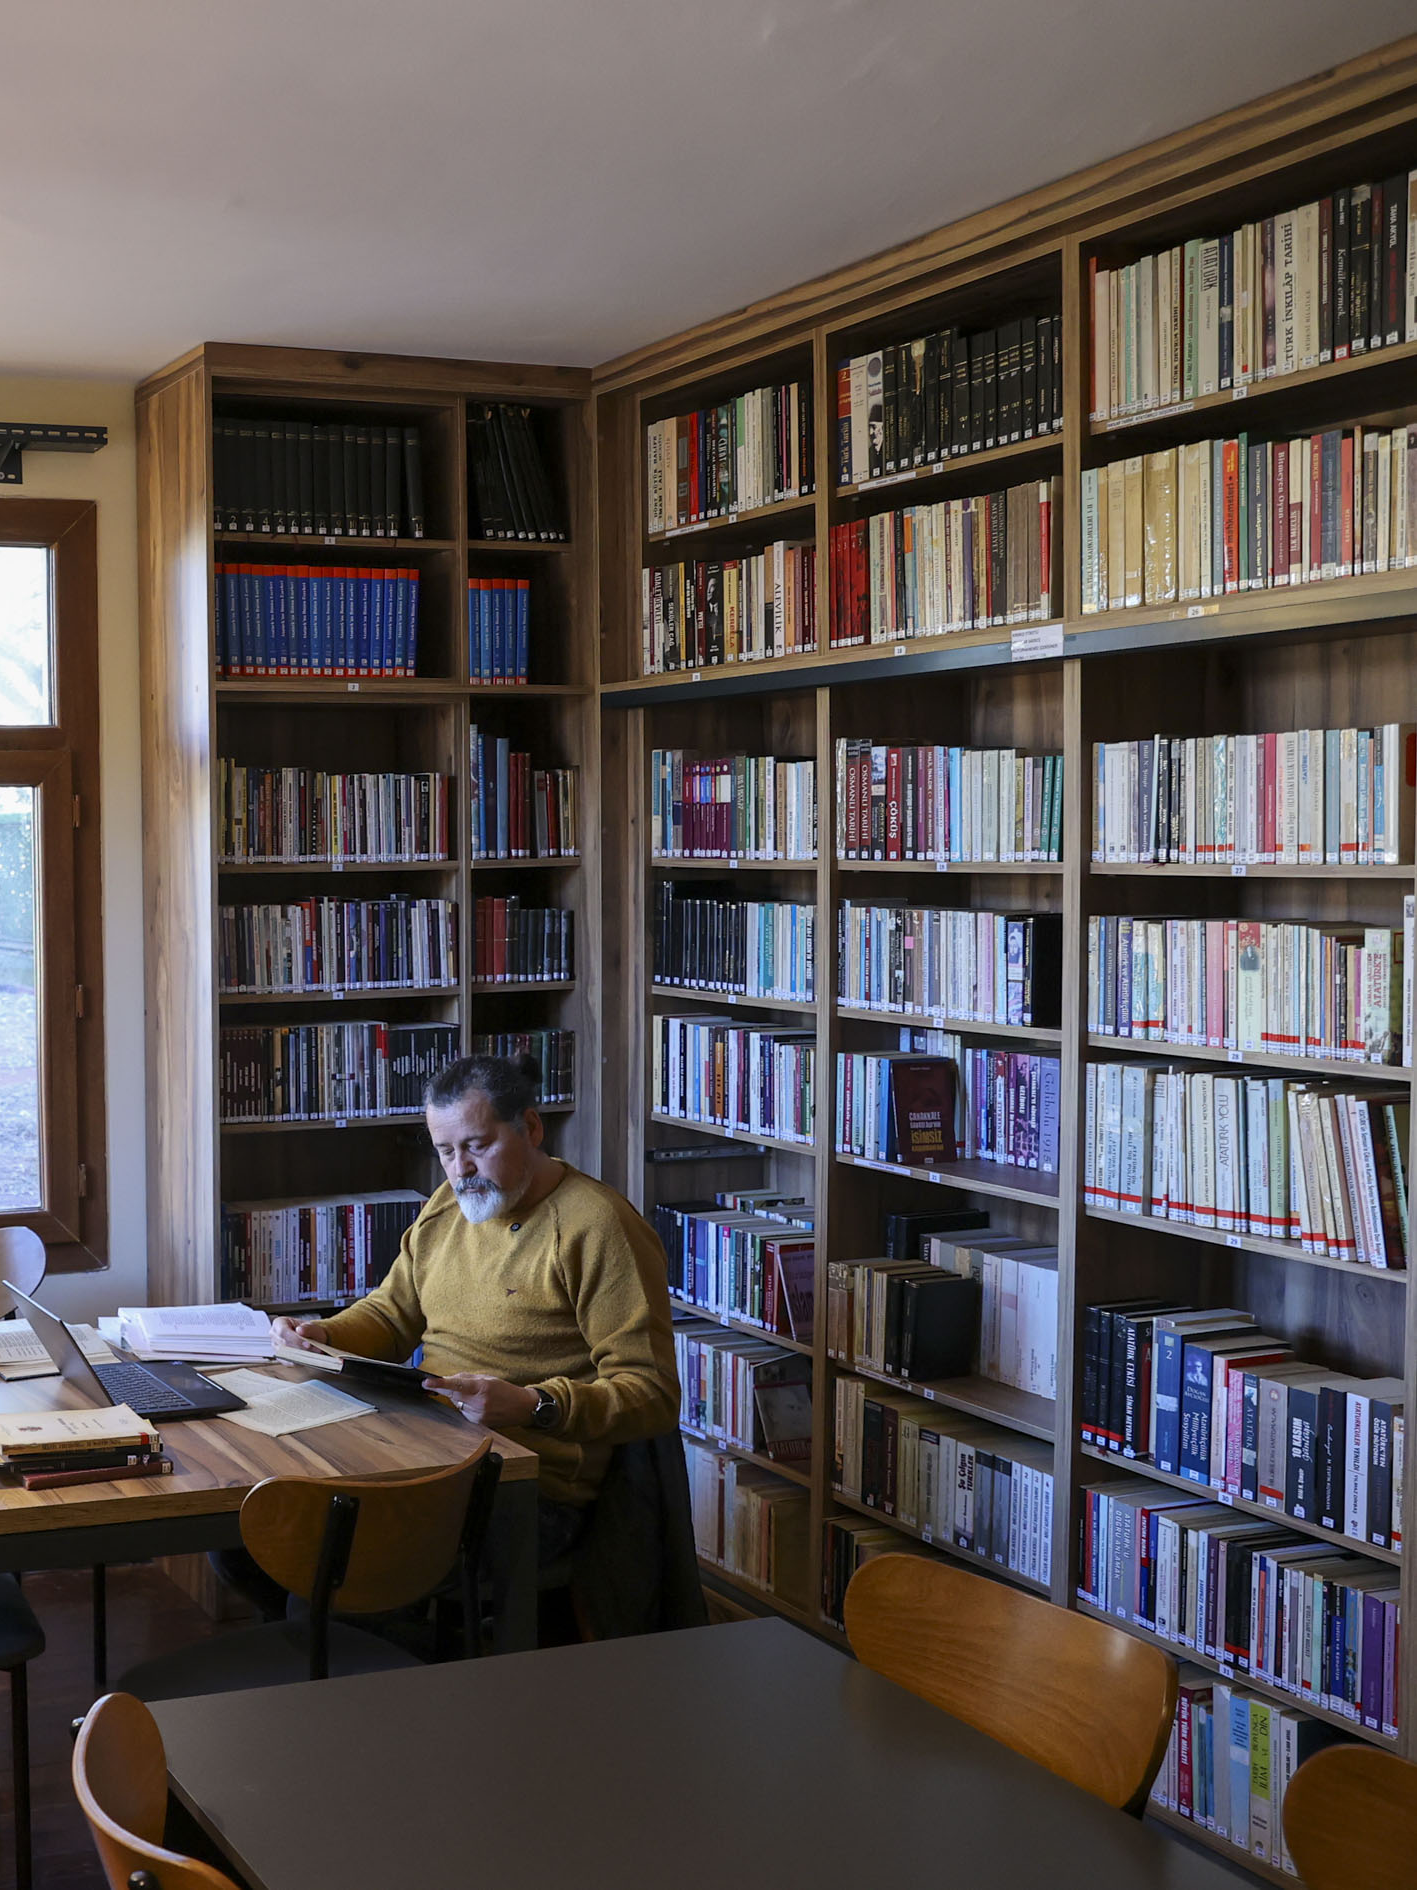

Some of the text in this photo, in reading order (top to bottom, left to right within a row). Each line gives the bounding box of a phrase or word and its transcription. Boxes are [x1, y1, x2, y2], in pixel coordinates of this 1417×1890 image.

[1281, 223, 1293, 362] TÜRK İNKILÂP TARİHİ
[1277, 451, 1285, 518] Bitmeyen Oyun
[775, 583, 783, 634] ALEVİLİK
[848, 767, 857, 842] OSMANLI TARİHİ
[861, 764, 869, 839] OSMANLI TARİHİ
[889, 800, 898, 839] ÇÖKÜŞ
[1121, 938, 1130, 966] Atatürk
[1120, 977, 1130, 1024] Atatürkçülük
[1373, 953, 1382, 1008] ATATÜRK'E
[1043, 1072, 1056, 1127] Gelibolu
[1218, 1095, 1229, 1166] ATATÜRK YOLU
[1166, 1350, 1172, 1360] 2
[1125, 1327, 1136, 1442] ATATÜRK ETKİSİ SİNAN MEYDAN
[1182, 1412, 1190, 1449] Sosyalizm
[1190, 1412, 1200, 1455] Milliyetçilik
[1199, 1412, 1209, 1461] Atatürkçülük
[1246, 1406, 1255, 1449] ATATÜRK
[1291, 1417, 1302, 1458] 10 KASIM
[1354, 1401, 1362, 1446] ATATÜRKÇÜLER
[1372, 1417, 1380, 1465] ÖZÜR DİLİYORUM
[1379, 1419, 1387, 1467] ATATÜRK'TEN
[958, 1453, 968, 1490] Şu Çılgın
[965, 1454, 973, 1492] TÜRKLER
[1114, 1540, 1122, 1579] ANLAMAK
